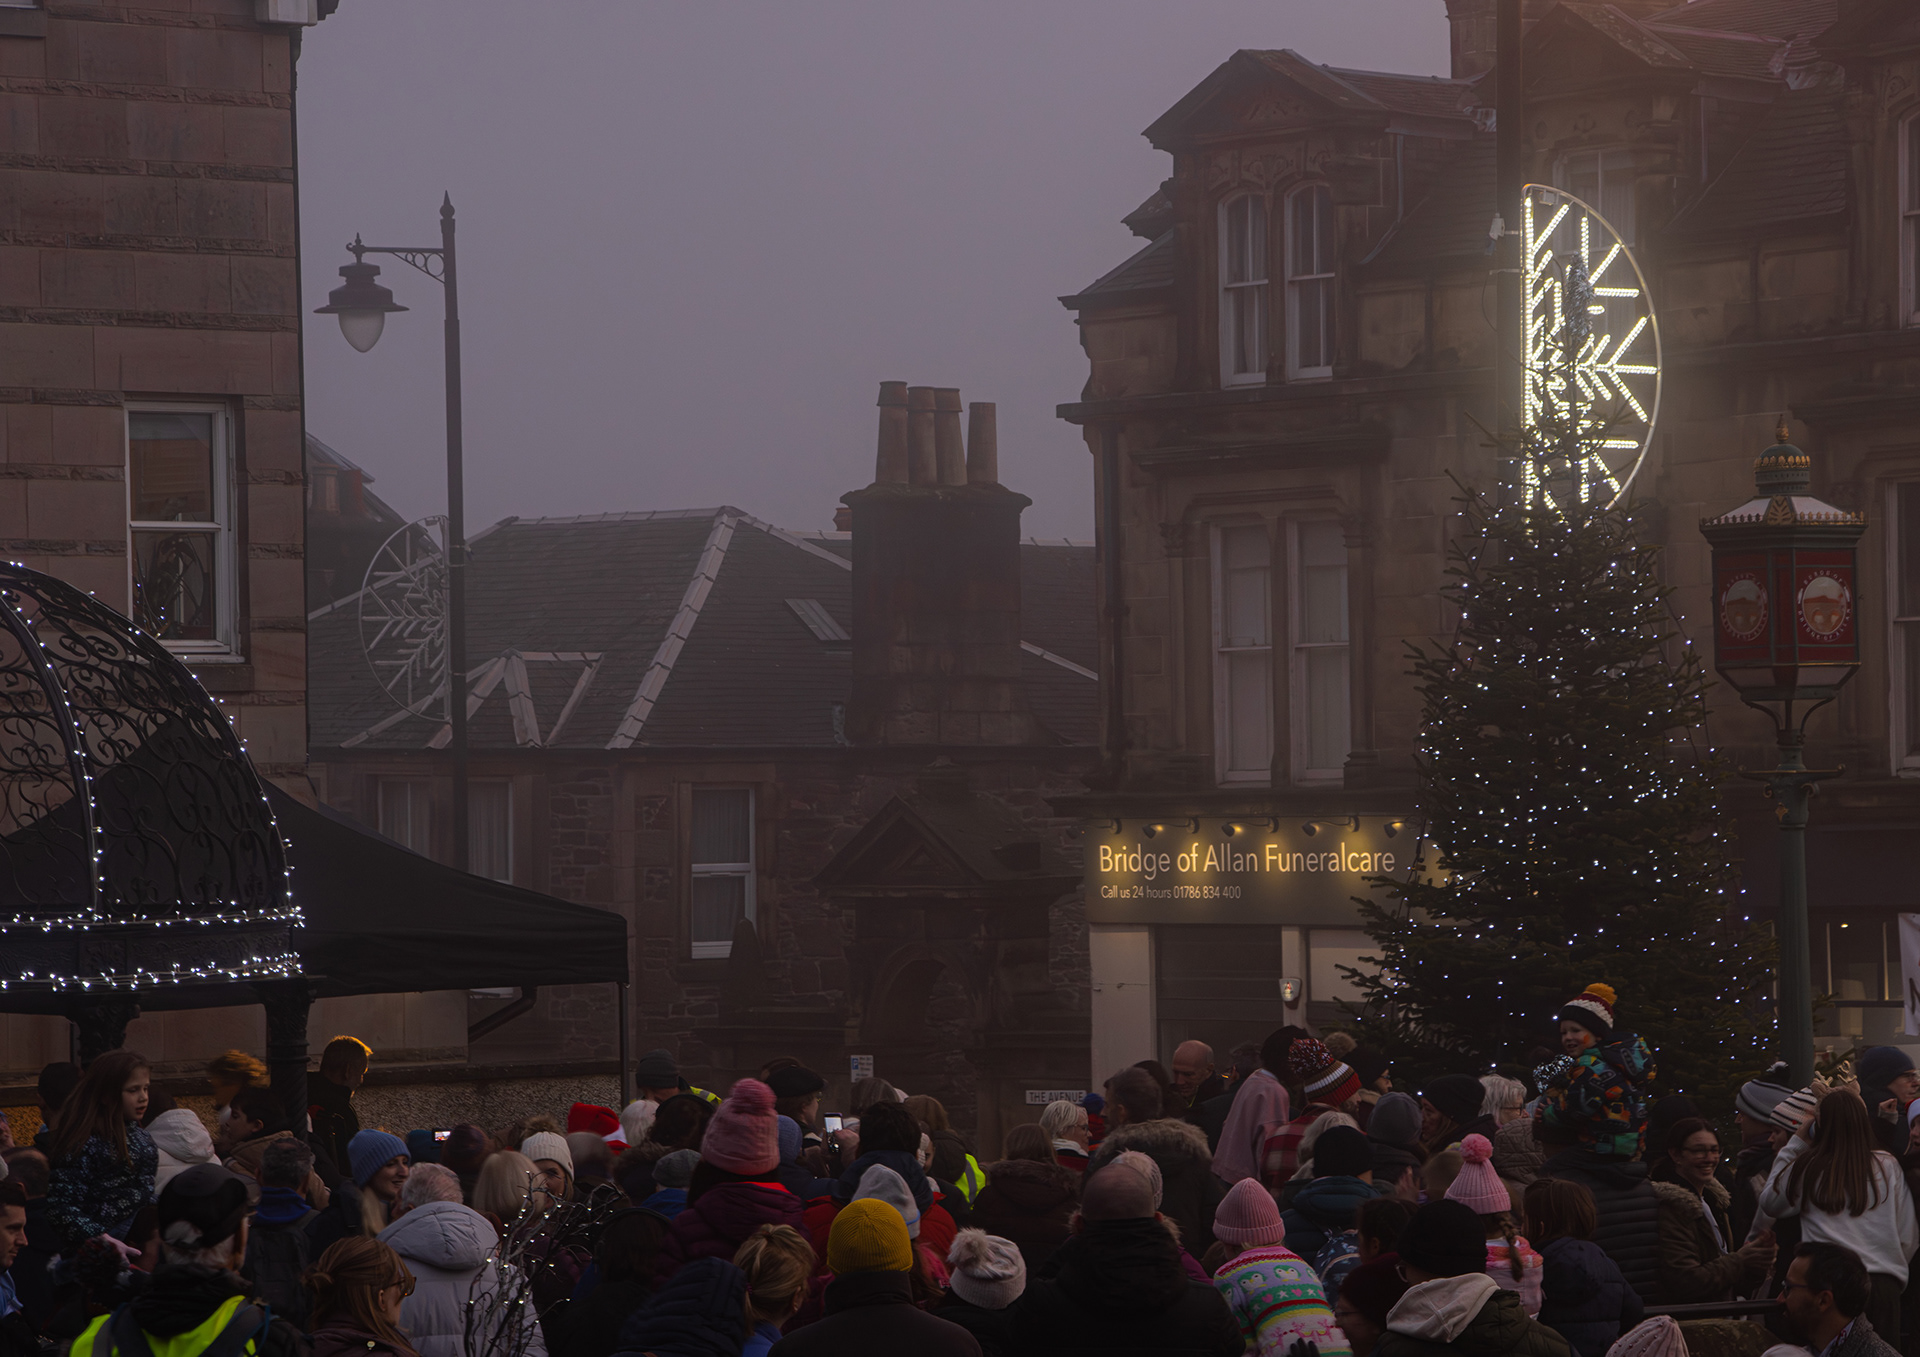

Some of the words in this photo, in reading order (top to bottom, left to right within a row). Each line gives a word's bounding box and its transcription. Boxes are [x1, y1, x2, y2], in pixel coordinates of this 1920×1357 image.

[1099, 843, 1171, 881] Bridge
[1177, 842, 1199, 873] of
[1203, 842, 1258, 873] Allan
[1265, 841, 1396, 873] Funeralcare
[1100, 885, 1118, 899] Call
[1120, 888, 1131, 899] us
[1132, 886, 1144, 899] 24
[1146, 885, 1172, 899] hours
[1173, 885, 1201, 899] 01786
[1202, 885, 1220, 899] 834
[1222, 885, 1241, 899] 400
[1029, 1091, 1046, 1103] THE
[1048, 1091, 1083, 1103] AVENUE
